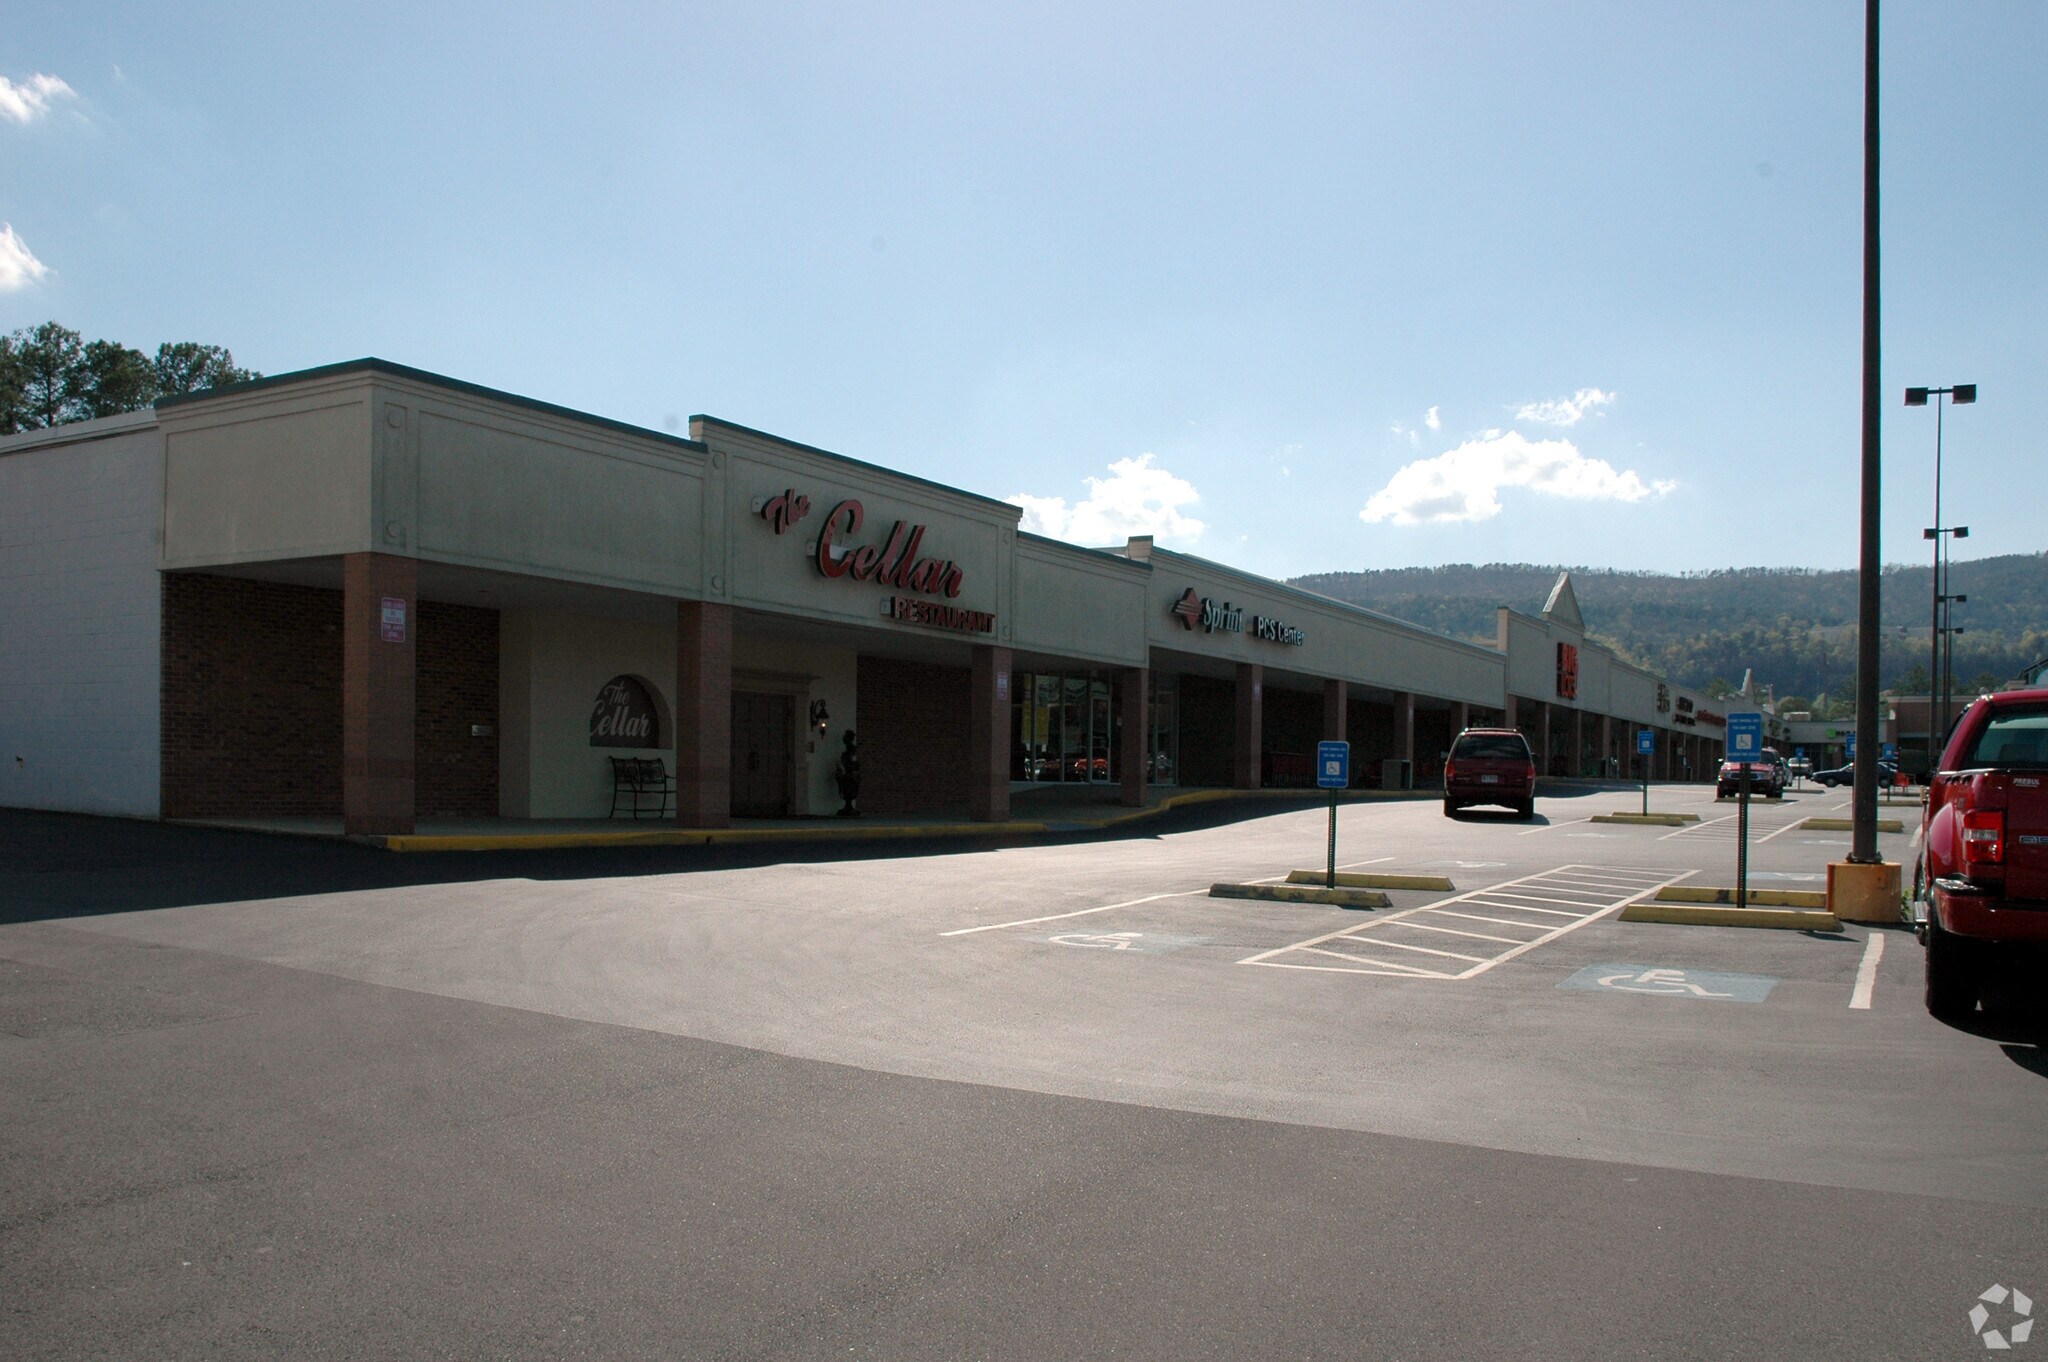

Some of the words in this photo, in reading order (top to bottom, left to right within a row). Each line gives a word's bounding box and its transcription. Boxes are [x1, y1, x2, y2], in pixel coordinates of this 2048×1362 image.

[761, 488, 811, 535] The
[816, 499, 964, 598] Cellar
[891, 596, 996, 633] RESTAURANT
[1202, 597, 1244, 633] Sprint
[1255, 616, 1276, 641] PCS
[1277, 621, 1305, 646] Center
[604, 680, 631, 705] The
